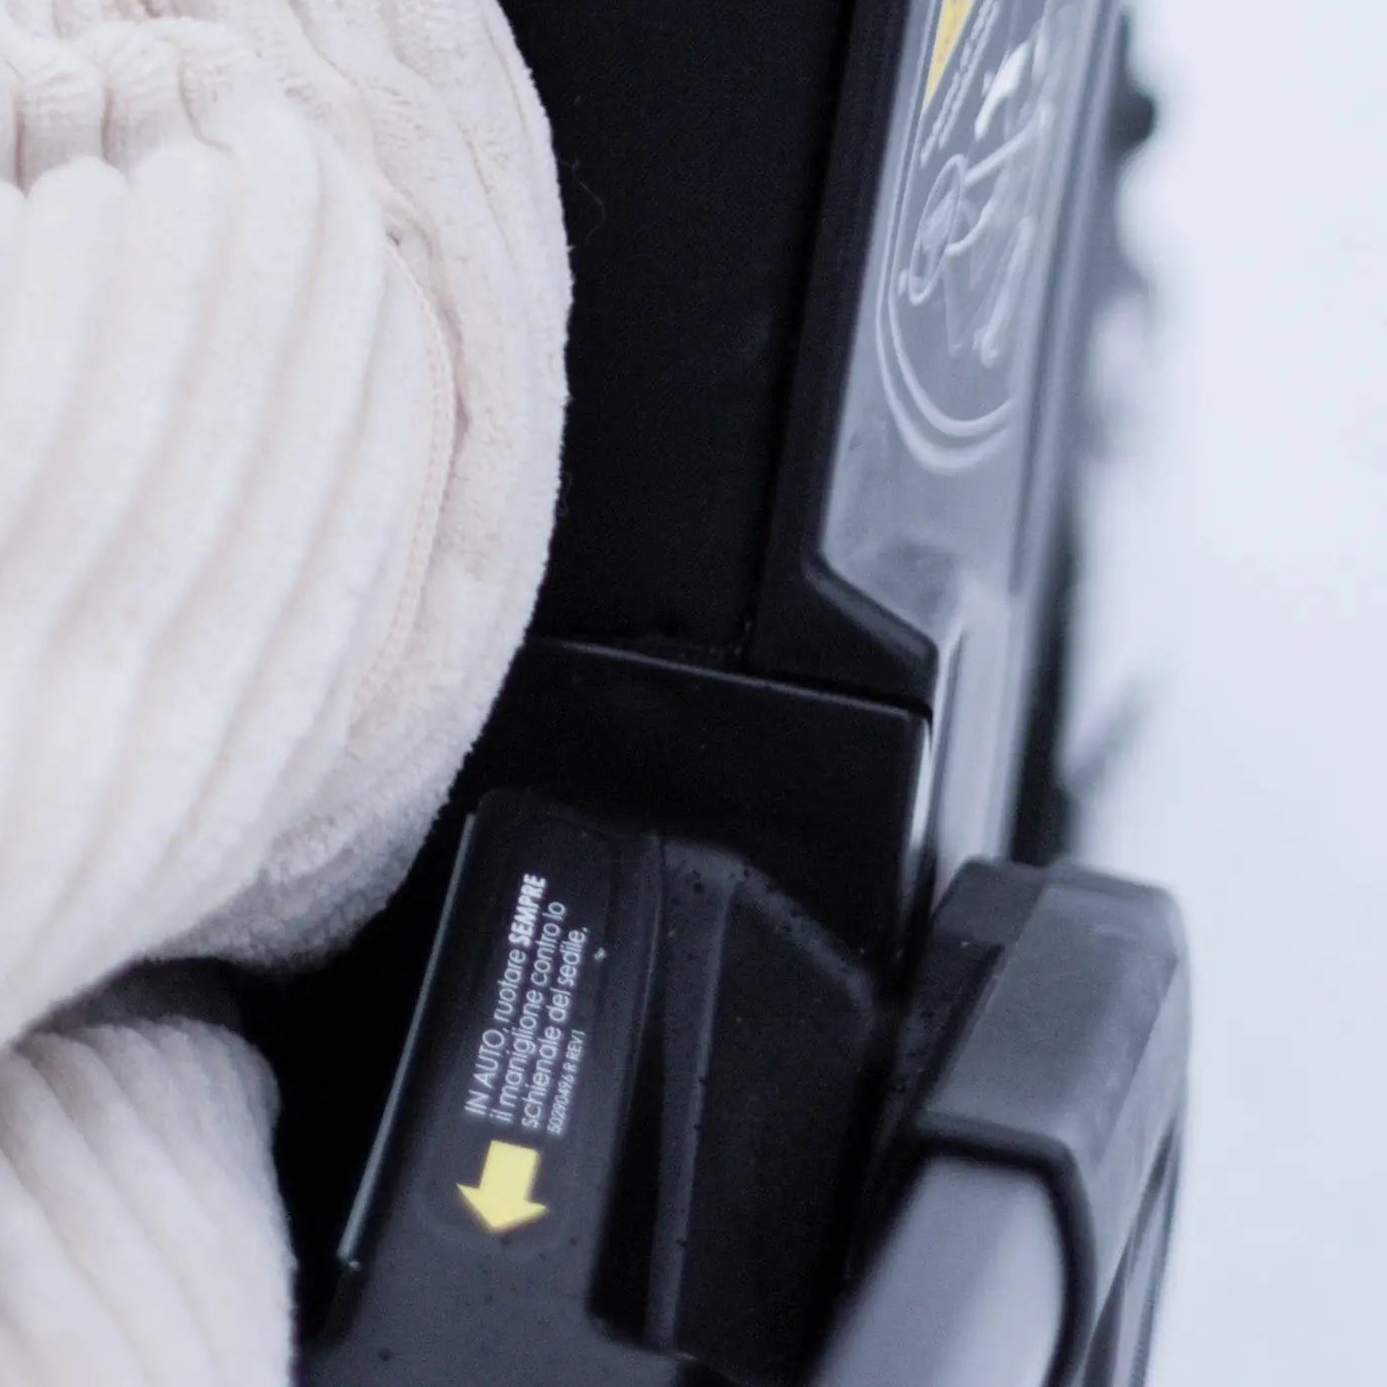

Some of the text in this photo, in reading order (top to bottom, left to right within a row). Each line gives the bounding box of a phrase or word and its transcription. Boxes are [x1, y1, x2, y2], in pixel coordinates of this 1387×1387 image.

[465, 874, 547, 1115] IN AUTO, ruotare SEMPRE
[489, 901, 566, 1122] il maniglione contro lo
[521, 1026, 561, 1128] schienale
[547, 987, 572, 1023] del
